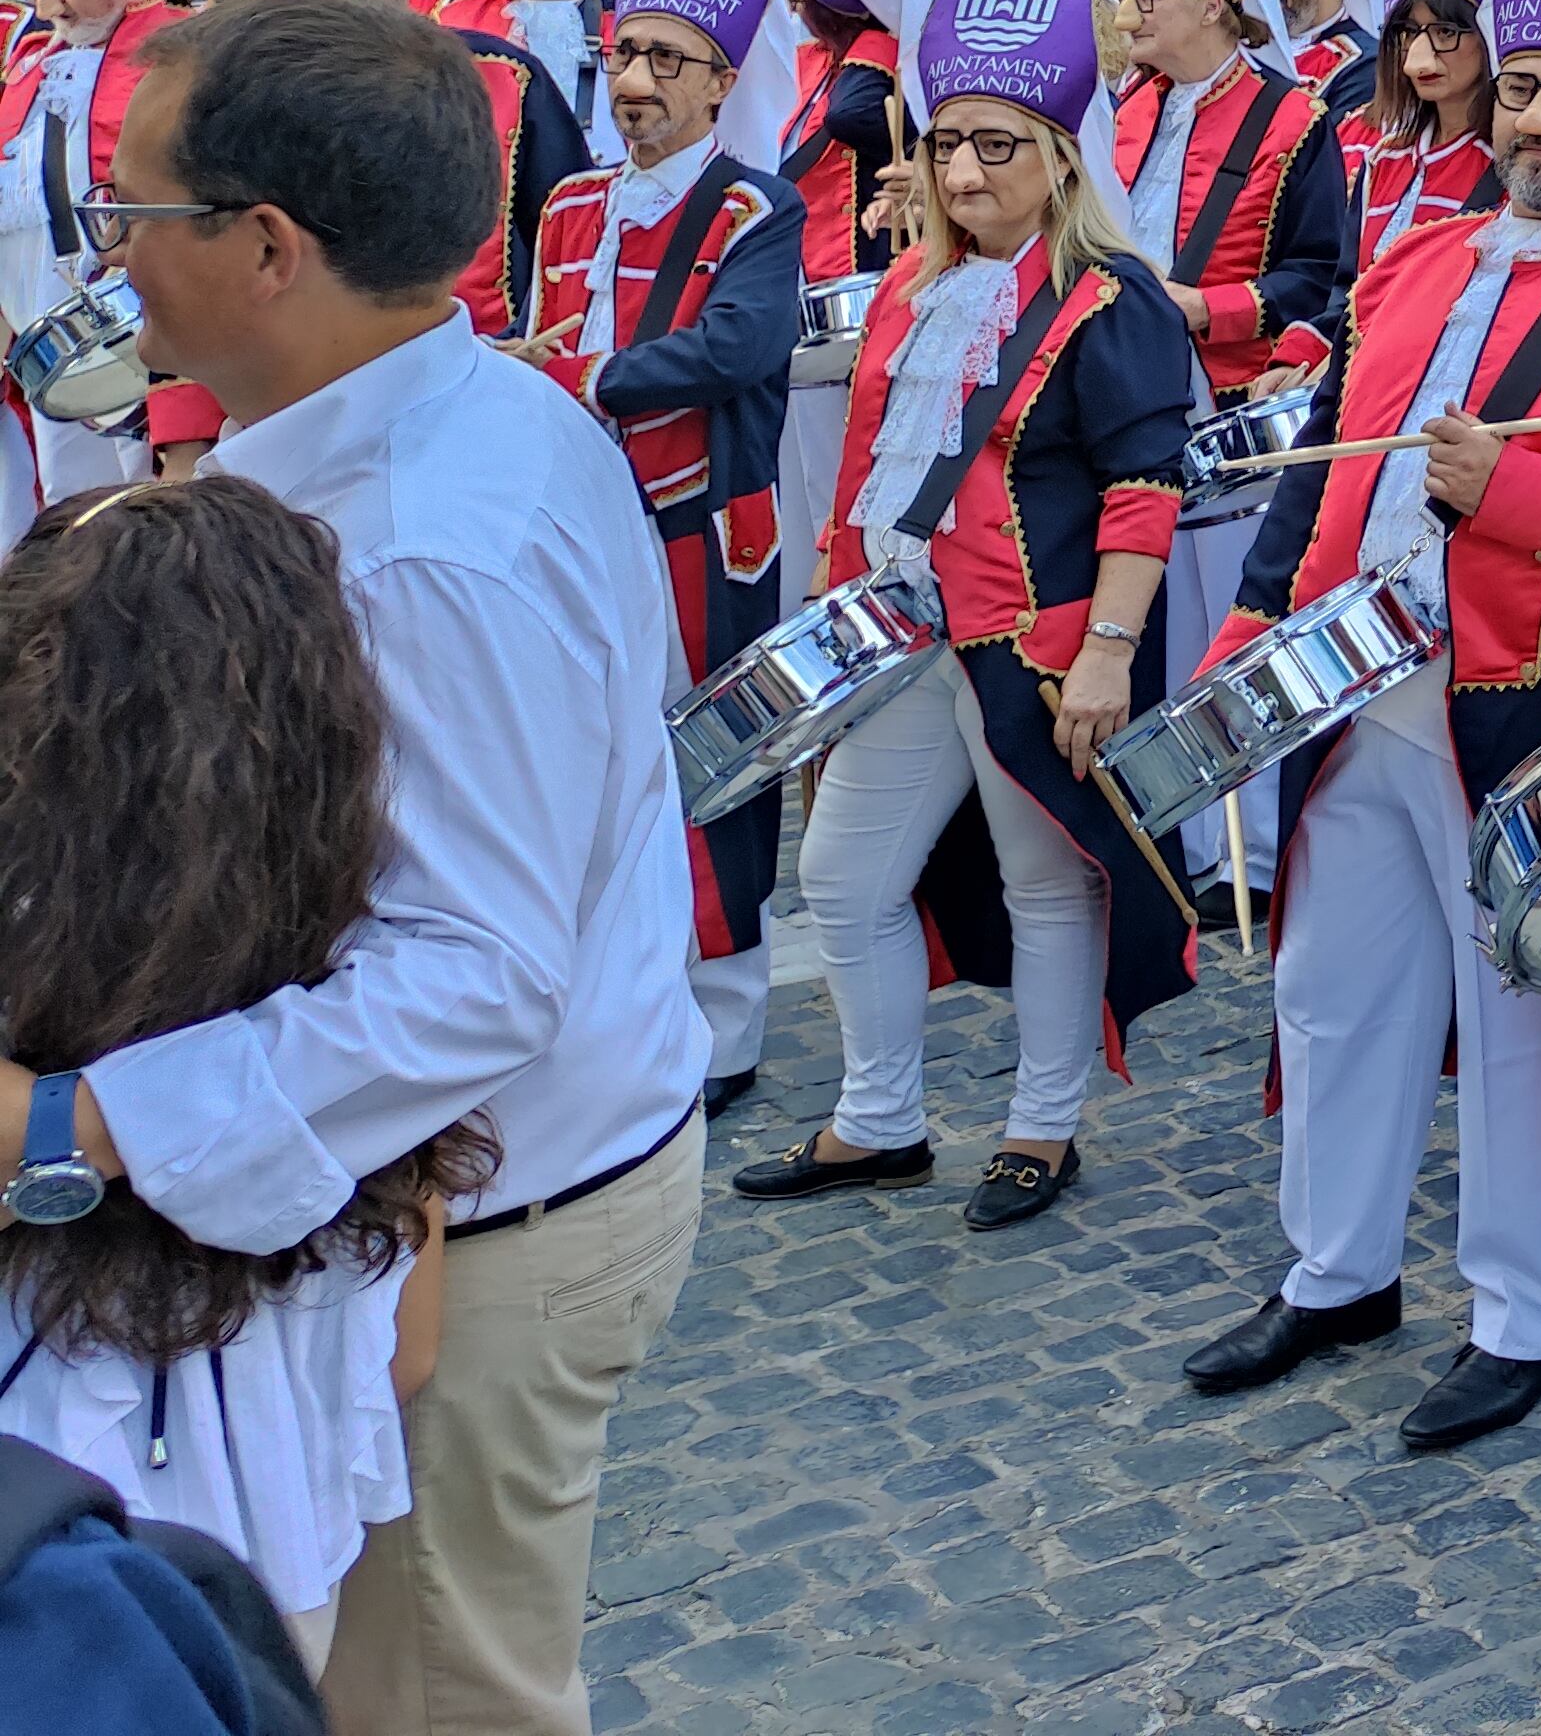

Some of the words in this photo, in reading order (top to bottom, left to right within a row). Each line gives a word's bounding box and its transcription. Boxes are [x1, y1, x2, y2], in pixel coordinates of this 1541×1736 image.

[1500, 22, 1518, 45] DE
[928, 54, 1067, 85] AJUNTAMENT
[932, 76, 951, 99] DE
[954, 77, 1045, 103] GANDIA
